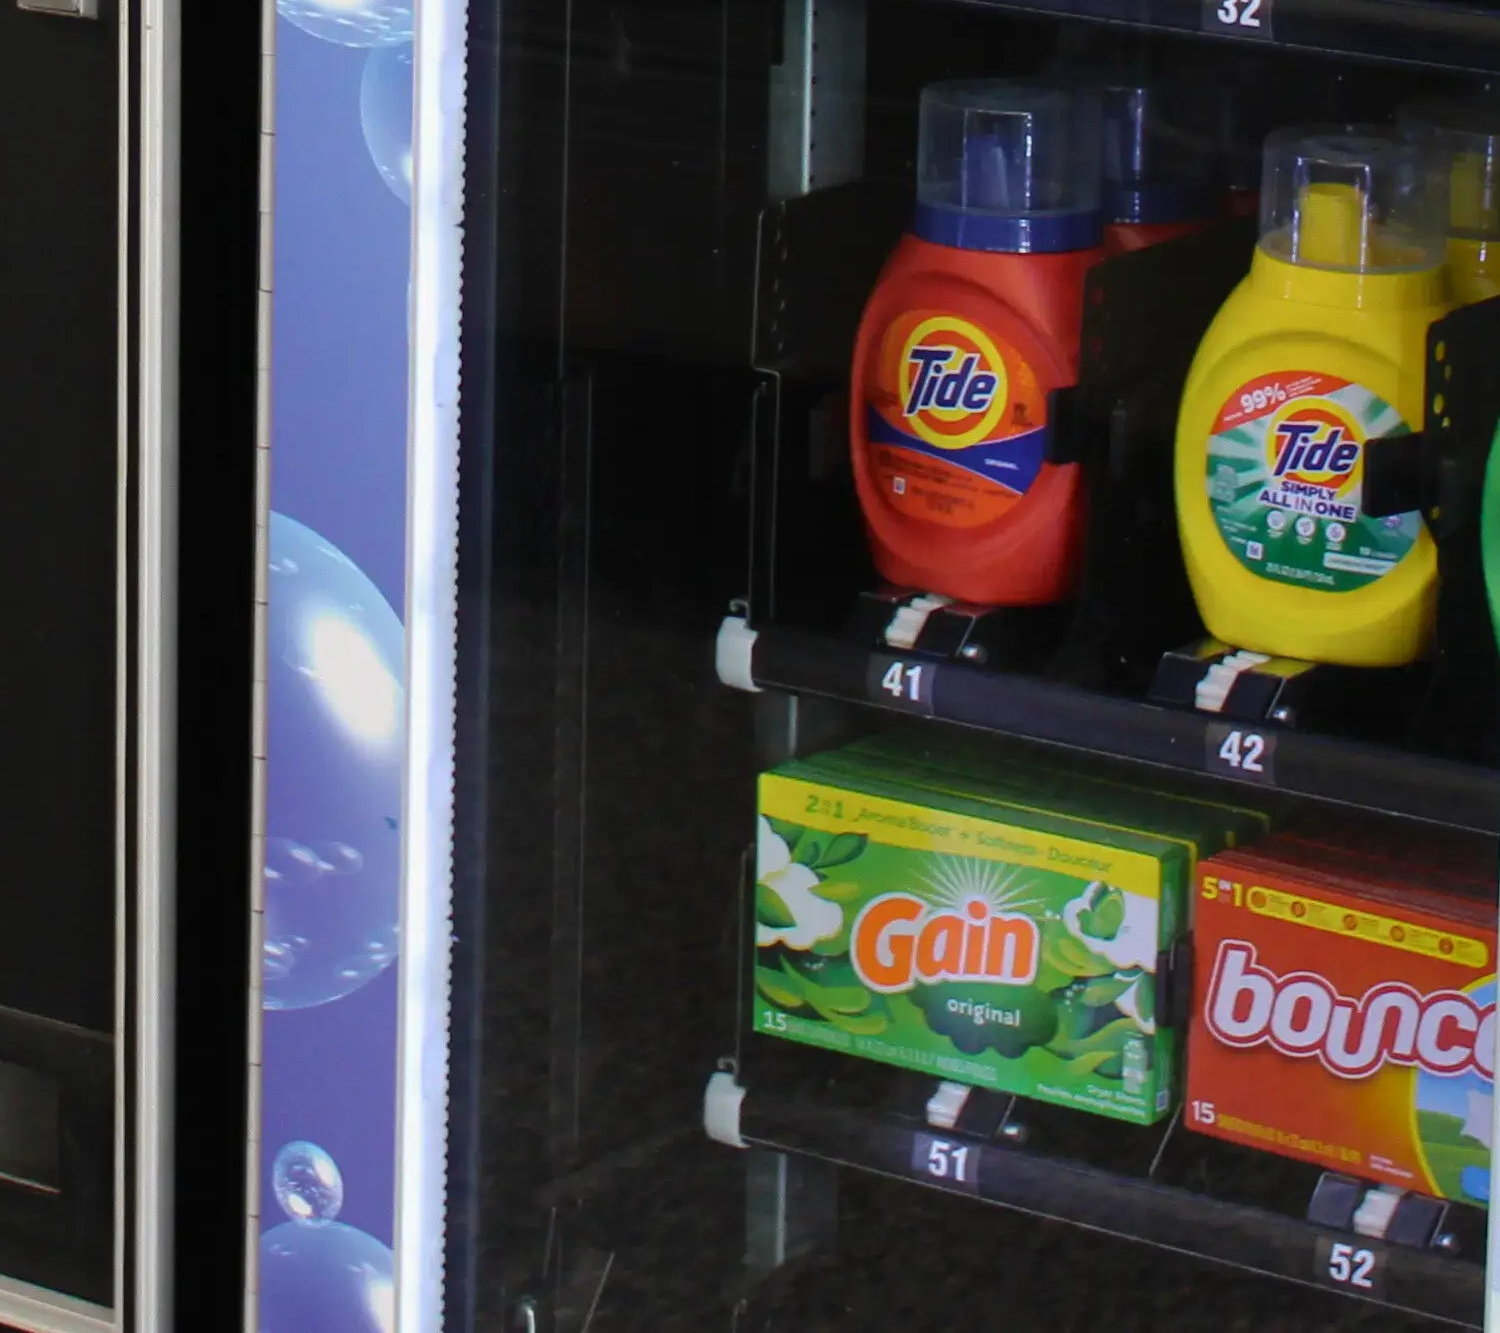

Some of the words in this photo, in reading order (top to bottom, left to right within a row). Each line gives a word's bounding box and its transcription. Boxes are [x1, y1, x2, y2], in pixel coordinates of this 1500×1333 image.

[902, 345, 999, 418] Tide
[1241, 382, 1287, 414] 99%
[1272, 421, 1362, 479] Tide
[1259, 490, 1291, 509] ALL
[1294, 498, 1313, 512] IN
[1315, 504, 1356, 520] ONE
[1281, 481, 1336, 501] SIMPLY
[880, 662, 924, 702] 41
[1218, 732, 1266, 772] 42
[805, 794, 819, 814] 2
[1201, 876, 1218, 900] 5
[1232, 883, 1243, 907] 1
[851, 894, 1042, 996] Gain
[762, 1010, 787, 1032] 15
[946, 998, 1021, 1028] original
[1192, 1100, 1216, 1124] 15
[928, 1142, 970, 1184] 51
[1328, 1244, 1376, 1288] 52
